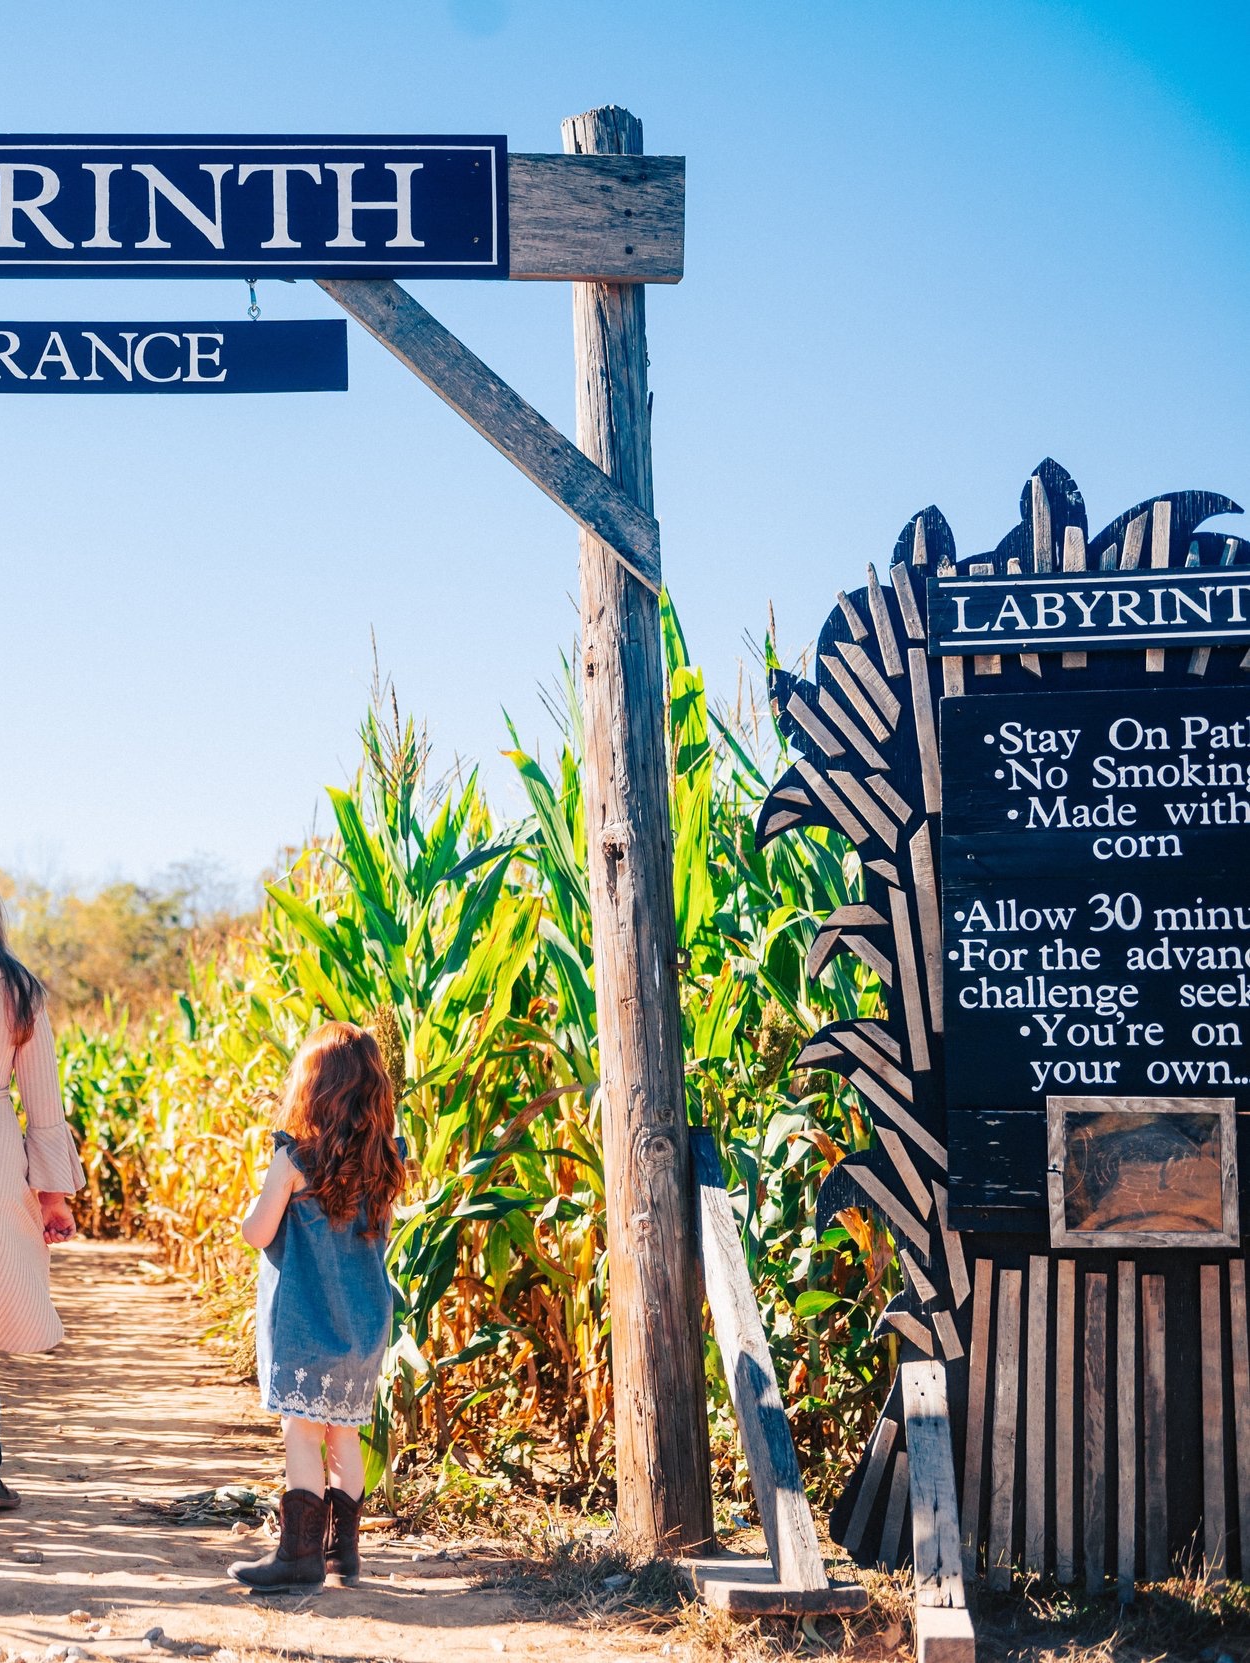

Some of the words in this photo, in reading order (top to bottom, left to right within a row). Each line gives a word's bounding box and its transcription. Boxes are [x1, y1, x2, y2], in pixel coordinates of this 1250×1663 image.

[999, 721, 1081, 760] Stay
[1108, 717, 1171, 751] On
[1180, 715, 1250, 749] Pat
[1005, 757, 1068, 791] No
[1092, 753, 1250, 791] Smokin
[1025, 794, 1137, 829] Made
[1163, 791, 1250, 826] with
[1092, 834, 1183, 860] corn
[961, 898, 1077, 933] Allow
[1088, 892, 1142, 932] 30
[958, 938, 1029, 972] For
[1038, 938, 1101, 971] the
[1126, 936, 1250, 971] advan
[958, 975, 1139, 1016] challenge
[1031, 1011, 1164, 1047] You're
[1191, 1022, 1243, 1047] on
[1029, 1060, 1121, 1092] your
